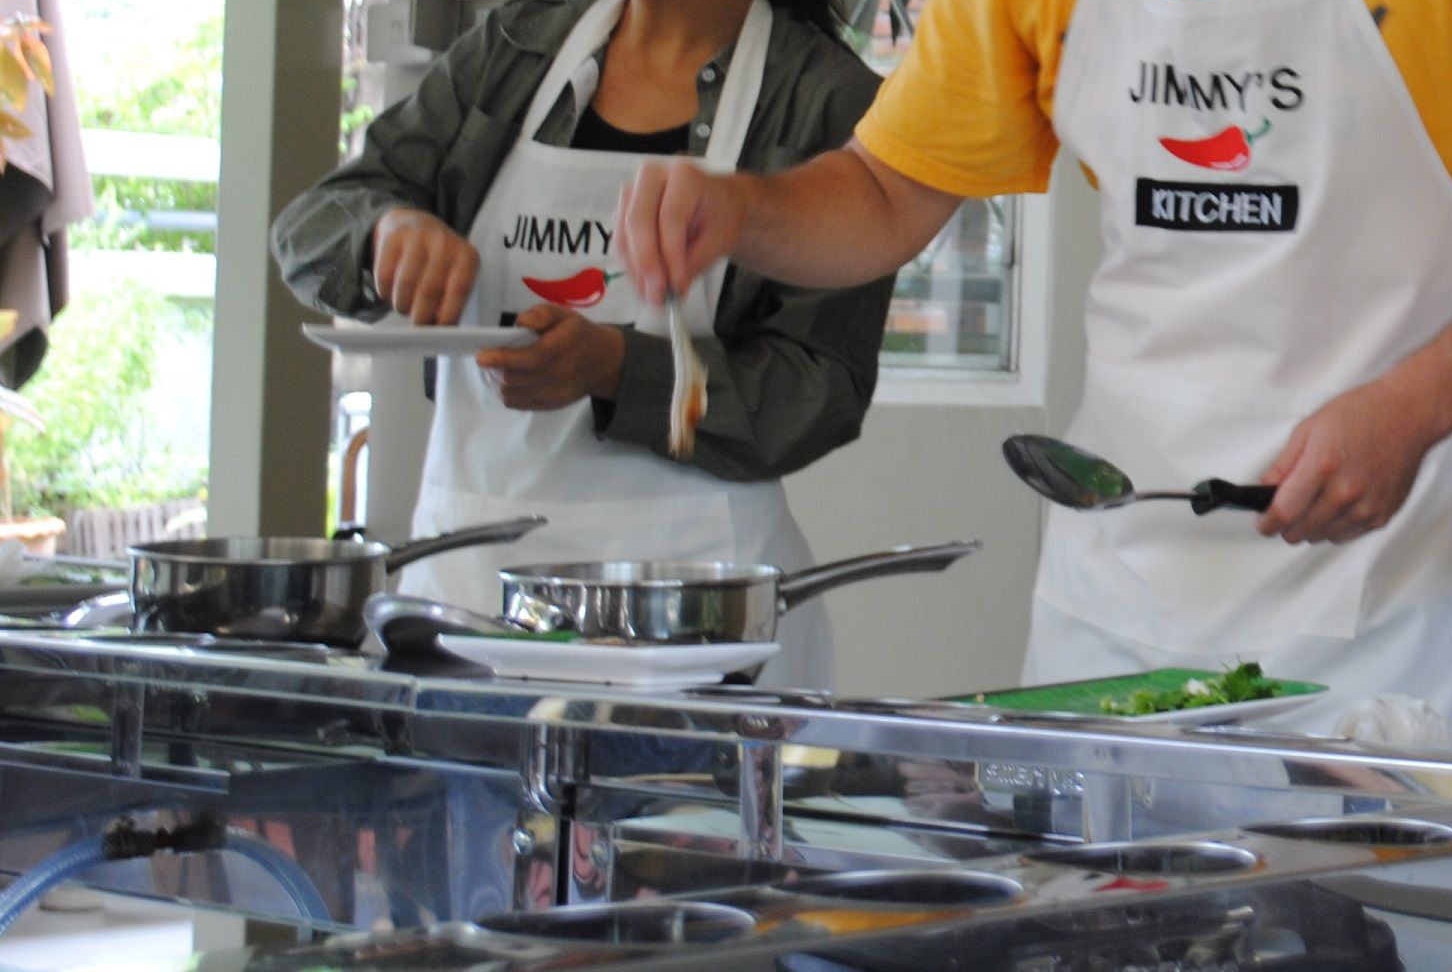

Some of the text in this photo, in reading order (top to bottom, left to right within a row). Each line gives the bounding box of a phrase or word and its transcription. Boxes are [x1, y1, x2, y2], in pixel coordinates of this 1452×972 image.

[1128, 60, 1305, 112] JIMMY'S
[1151, 187, 1283, 226] KITCHEN
[503, 214, 614, 255] JIMMY
